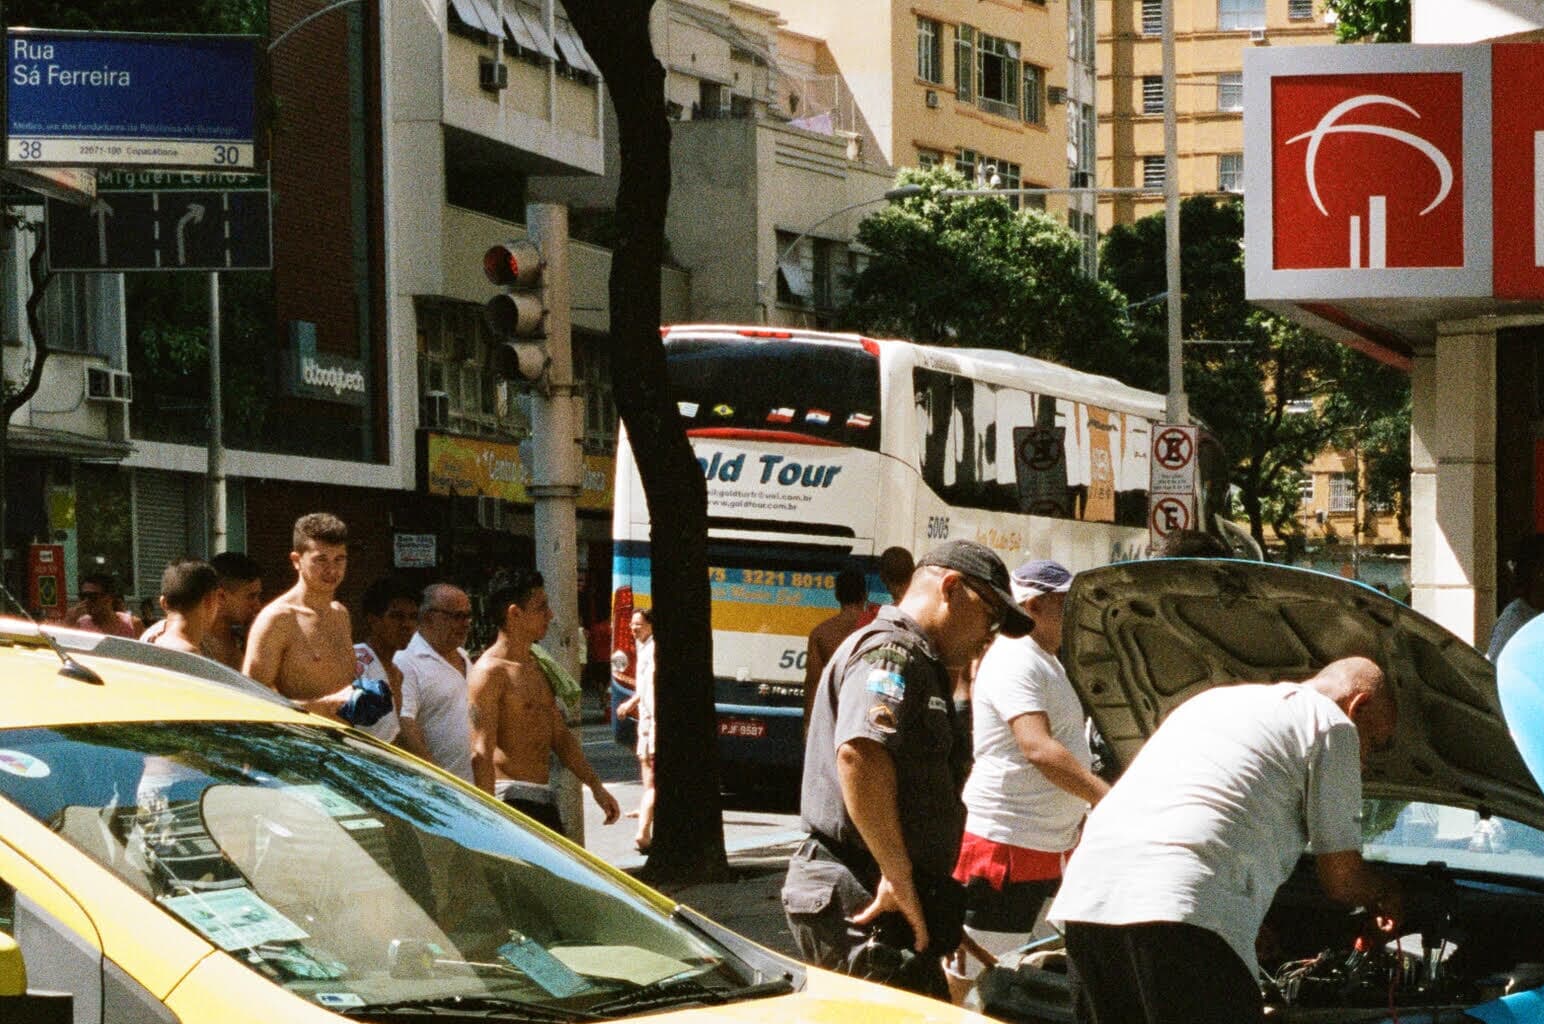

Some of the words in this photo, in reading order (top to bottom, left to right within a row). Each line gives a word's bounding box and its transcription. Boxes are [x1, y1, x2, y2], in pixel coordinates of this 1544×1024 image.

[14, 39, 54, 60] Rua
[14, 64, 40, 86] Sá
[48, 65, 130, 86] Ferreira
[19, 141, 41, 160] 38
[213, 145, 239, 165] 30
[759, 454, 842, 488] Tour
[927, 516, 950, 540] 5005
[742, 569, 786, 586] 3221
